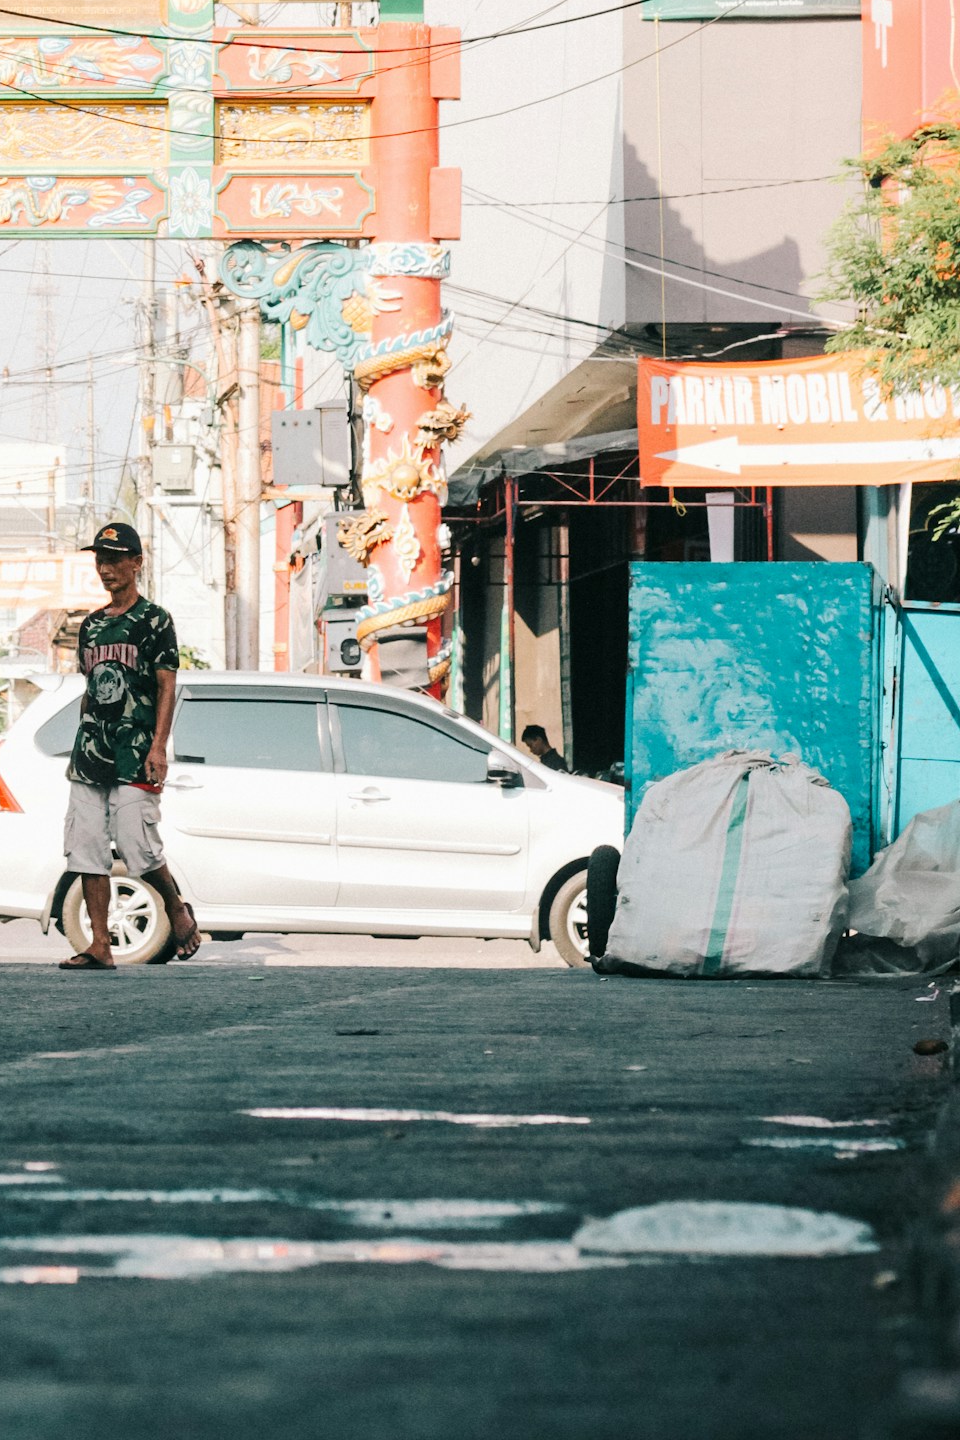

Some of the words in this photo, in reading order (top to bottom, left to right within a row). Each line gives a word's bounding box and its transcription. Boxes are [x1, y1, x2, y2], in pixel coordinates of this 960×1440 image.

[651, 375, 756, 426] PARKIR
[758, 372, 858, 425] MOBIL
[862, 377, 889, 421] &
